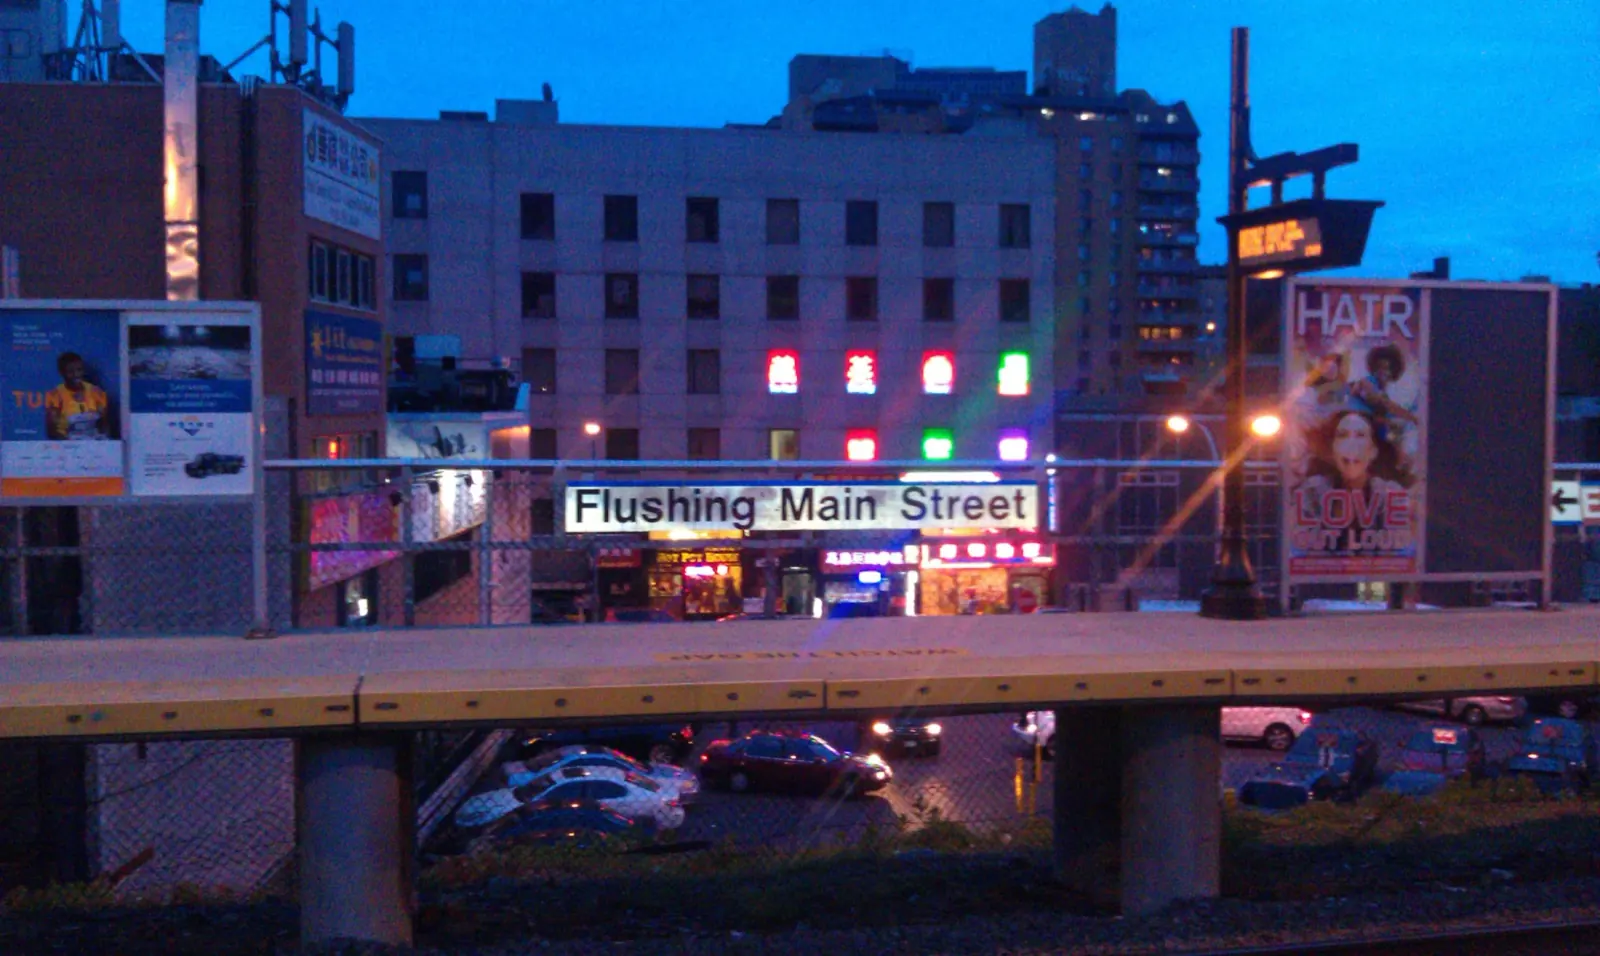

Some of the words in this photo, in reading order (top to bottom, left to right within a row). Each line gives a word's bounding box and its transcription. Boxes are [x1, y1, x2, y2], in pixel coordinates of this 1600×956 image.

[1297, 291, 1415, 339] HAIR
[575, 488, 756, 529] Flushing
[781, 488, 877, 521] Main
[900, 486, 1026, 520] Street
[1296, 489, 1411, 529] LOVE
